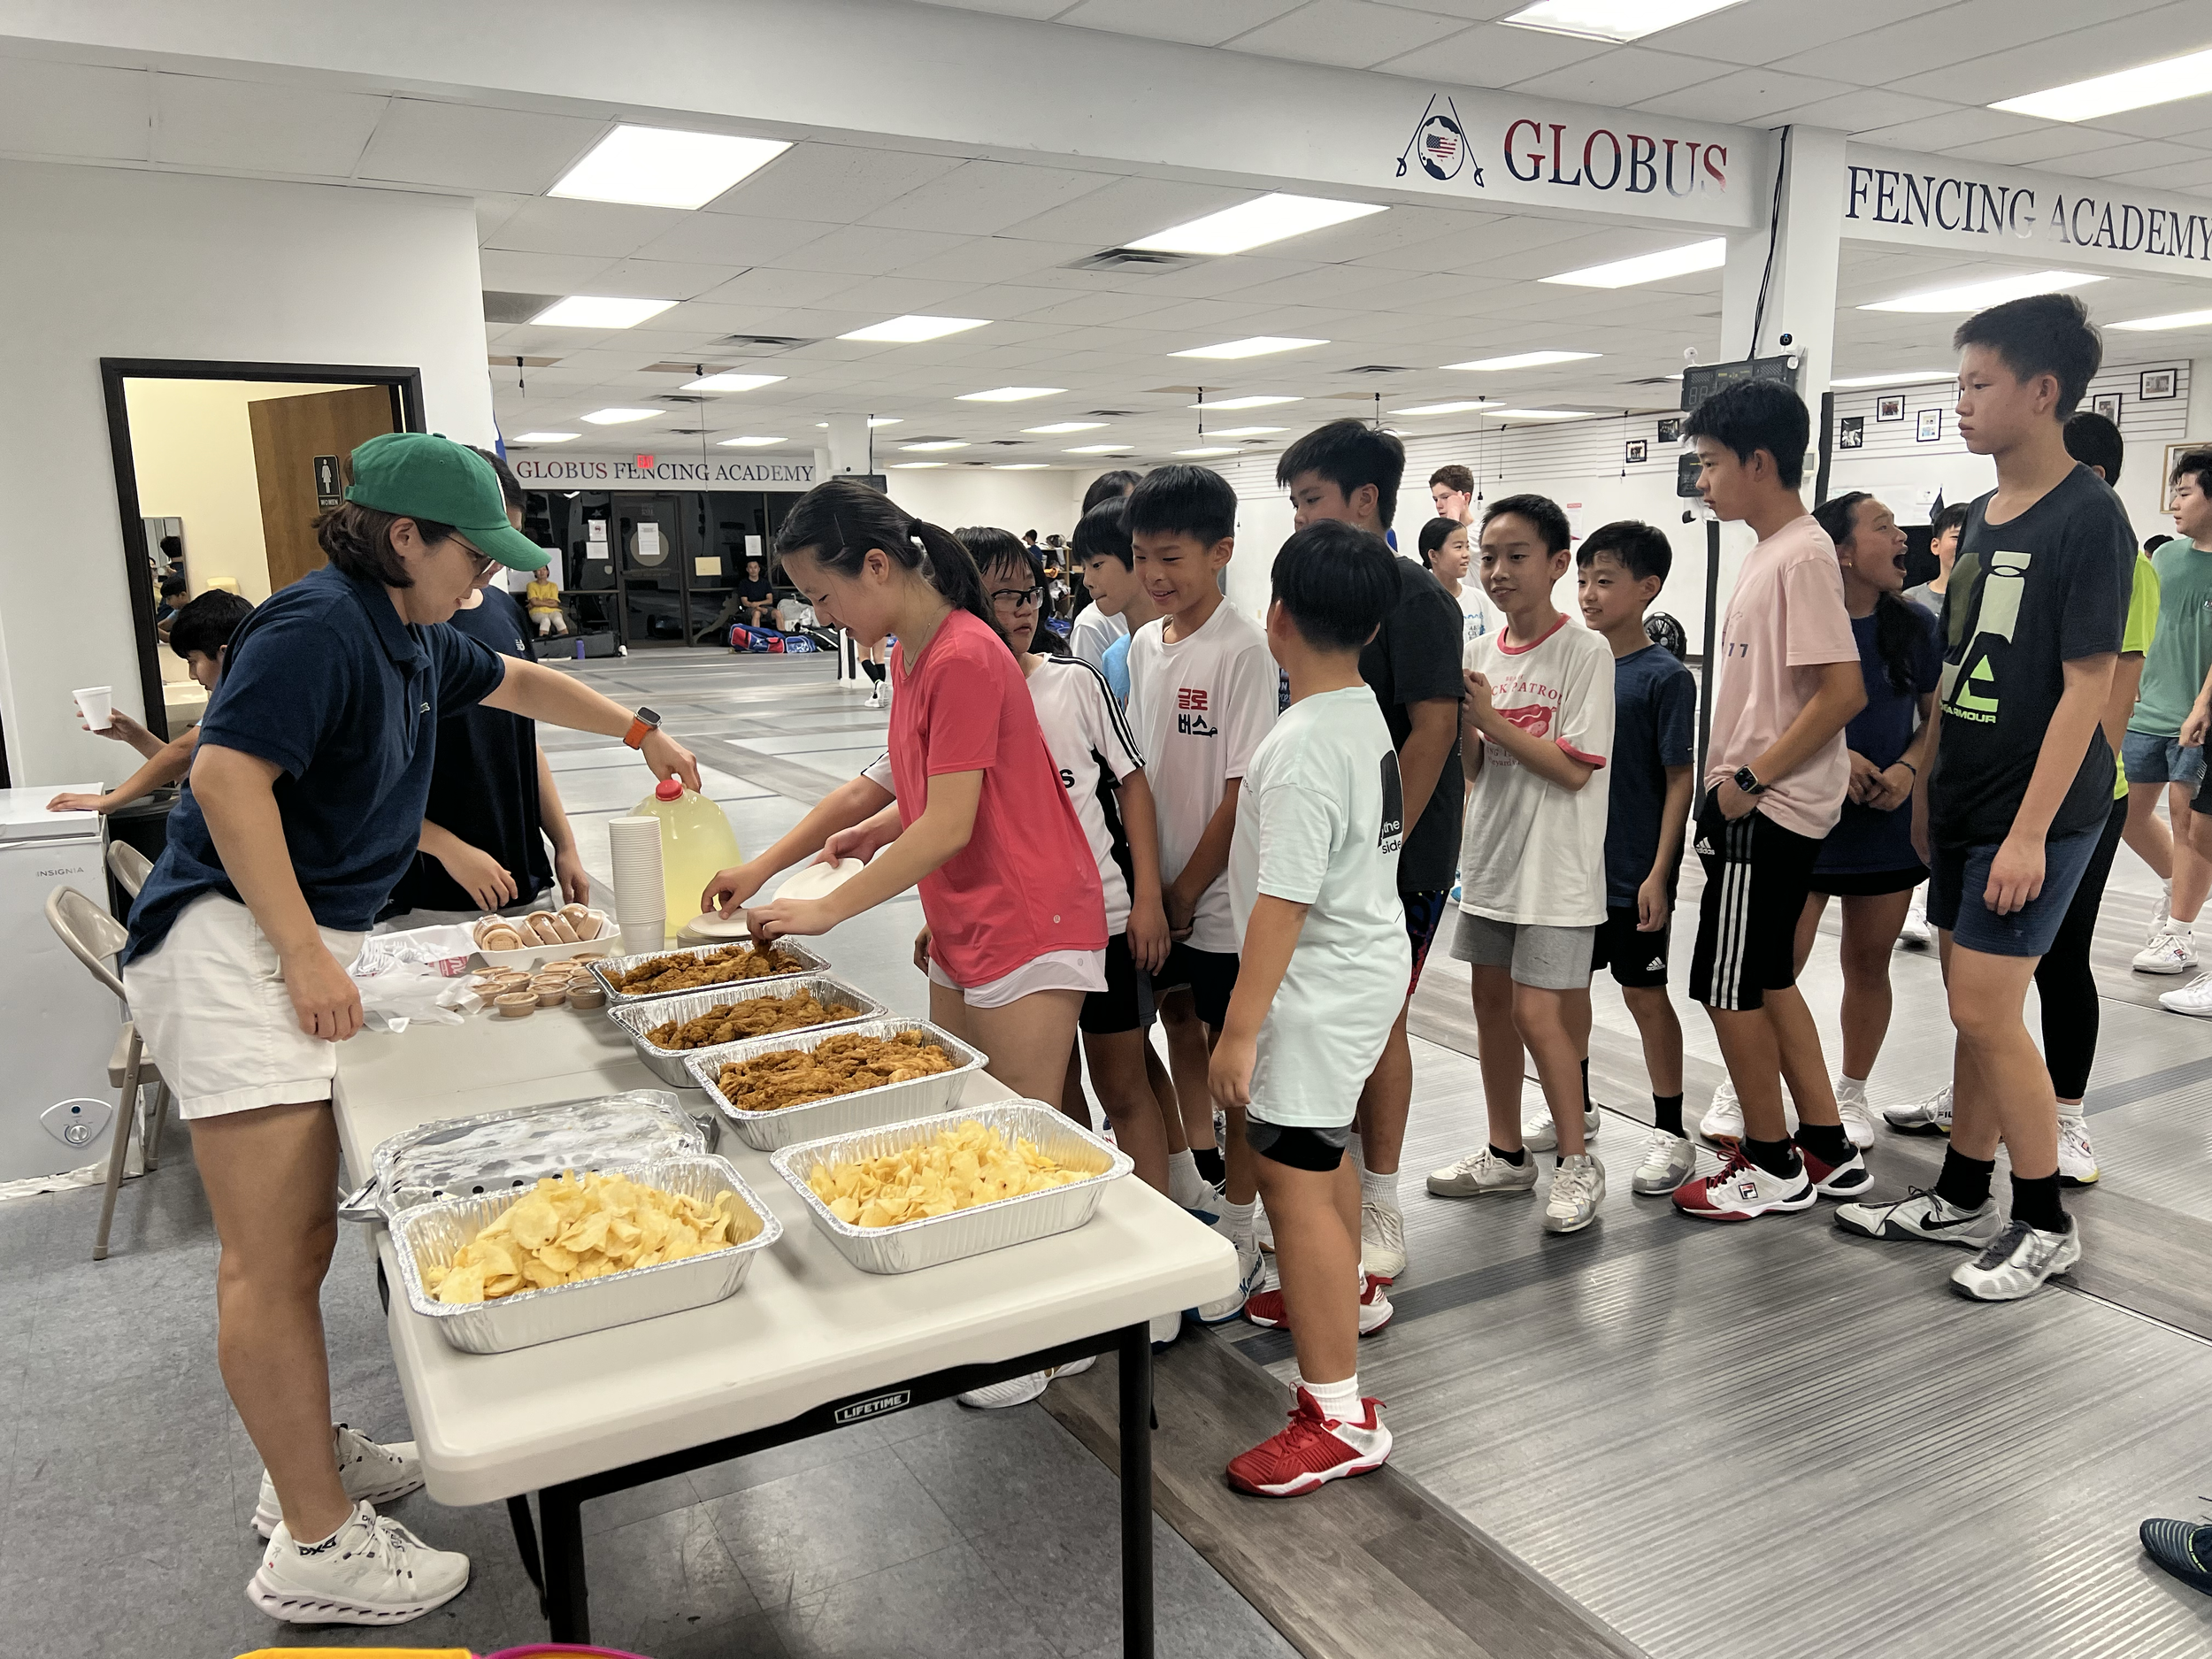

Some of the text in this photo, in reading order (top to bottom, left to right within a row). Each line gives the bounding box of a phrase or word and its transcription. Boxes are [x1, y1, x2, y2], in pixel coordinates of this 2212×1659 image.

[1504, 119, 1727, 200] GLOBUS
[1845, 165, 2212, 261] FENCING ACADEMY
[517, 461, 814, 481] GLOBUS FENCING ACADEMY
[637, 455, 654, 468] EXIT
[1178, 687, 1208, 711] 글로
[1178, 713, 1217, 738] 버스
[36, 867, 84, 877] INSIGNIA
[844, 1394, 902, 1418] LIFETIME
